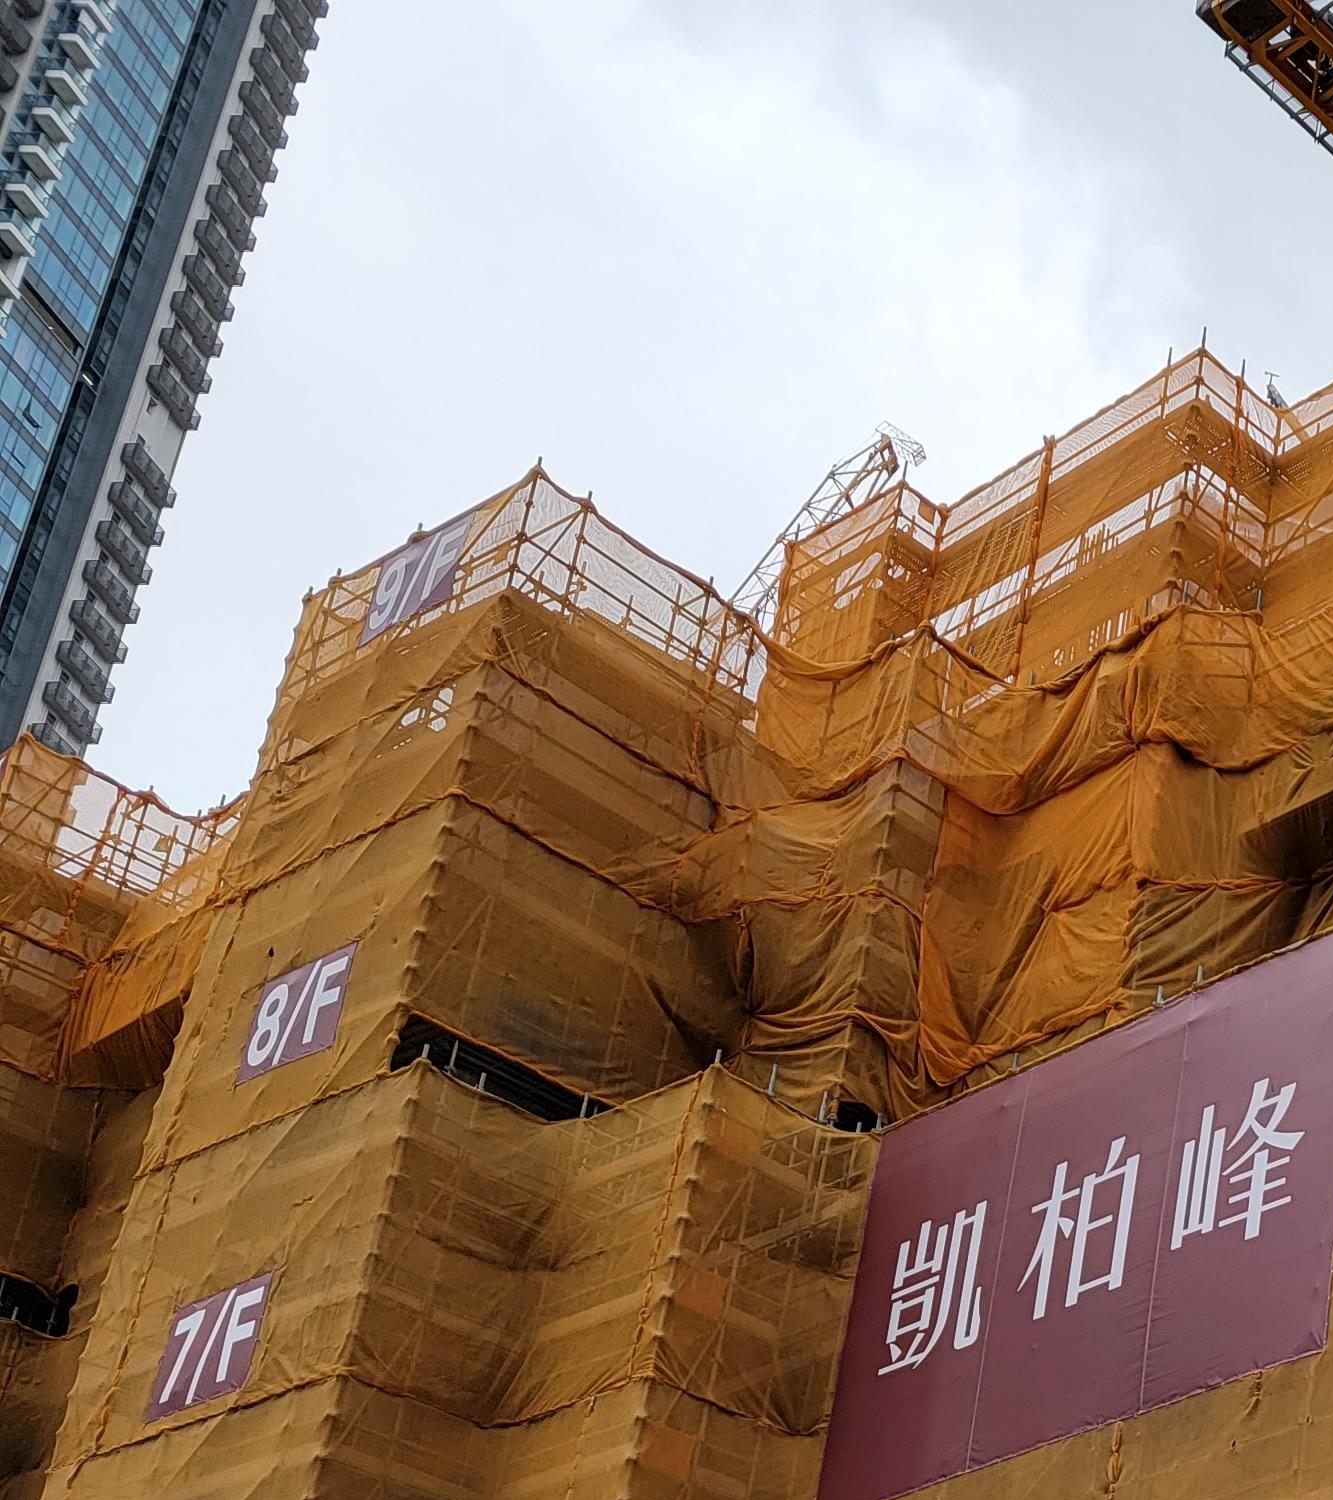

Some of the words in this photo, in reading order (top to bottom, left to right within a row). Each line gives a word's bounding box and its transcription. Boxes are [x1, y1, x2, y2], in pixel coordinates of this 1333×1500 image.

[369, 523, 468, 630] 9/F
[247, 955, 349, 1067] 8/F
[878, 1077, 1305, 1376] 凱柏峰
[159, 1285, 265, 1405] 7/F
